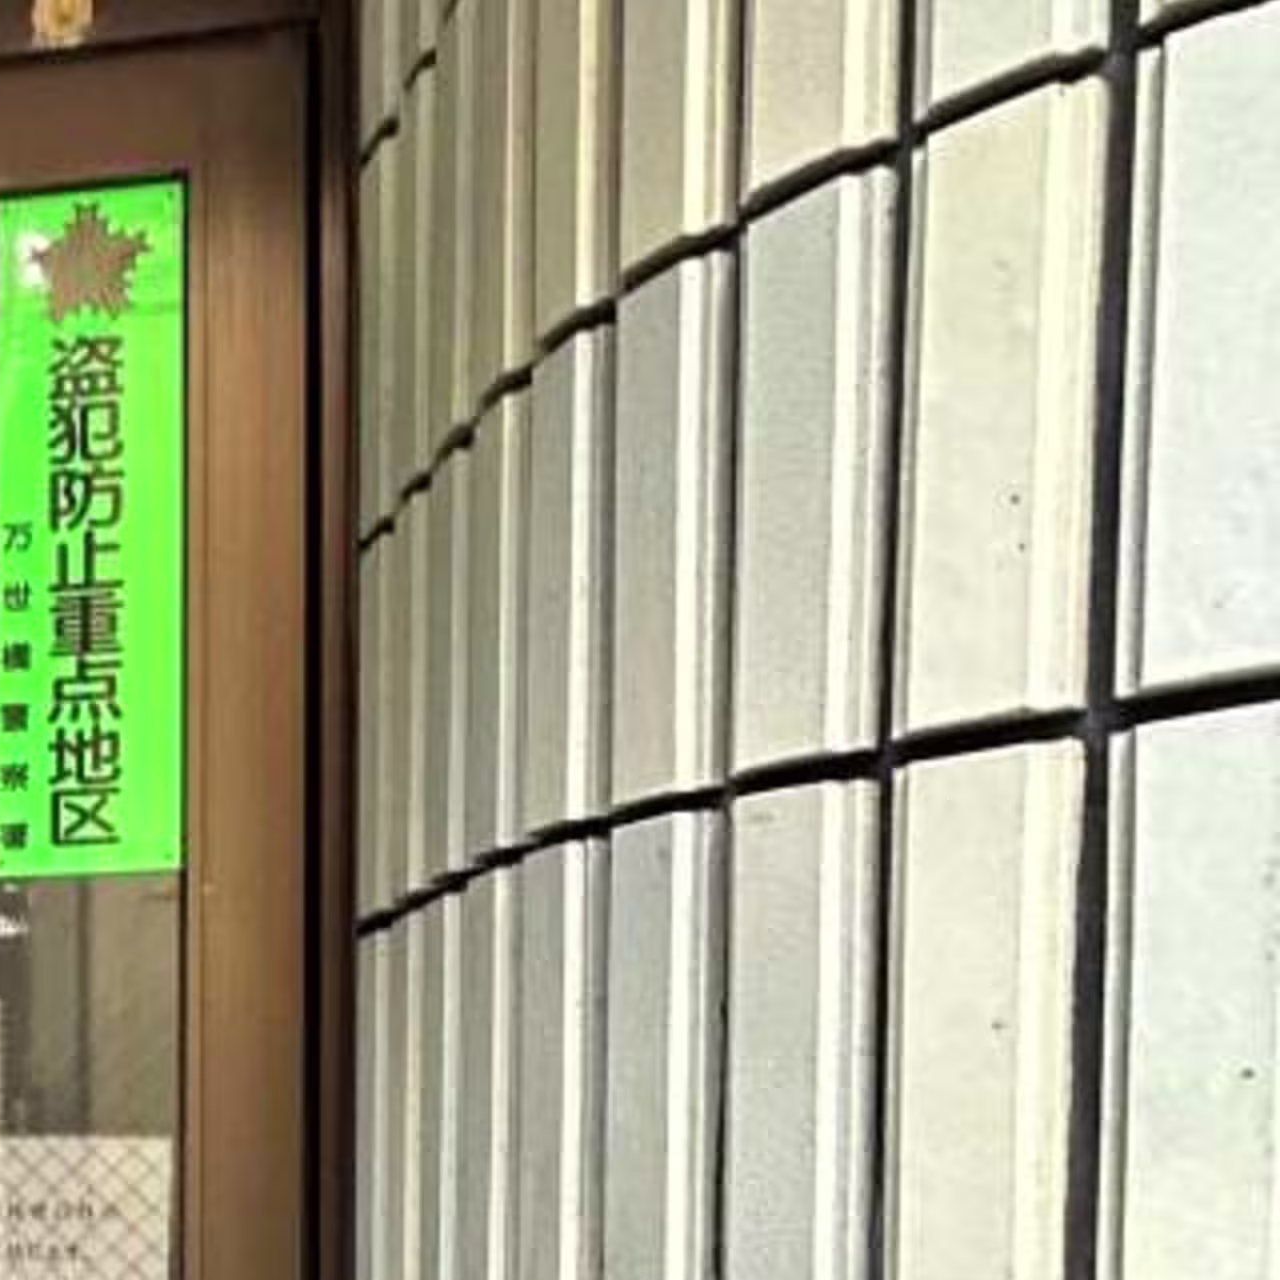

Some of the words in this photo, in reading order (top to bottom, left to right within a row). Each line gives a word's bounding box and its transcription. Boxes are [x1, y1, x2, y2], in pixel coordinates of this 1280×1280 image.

[47, 335, 125, 846] 盗犯防止重点地区
